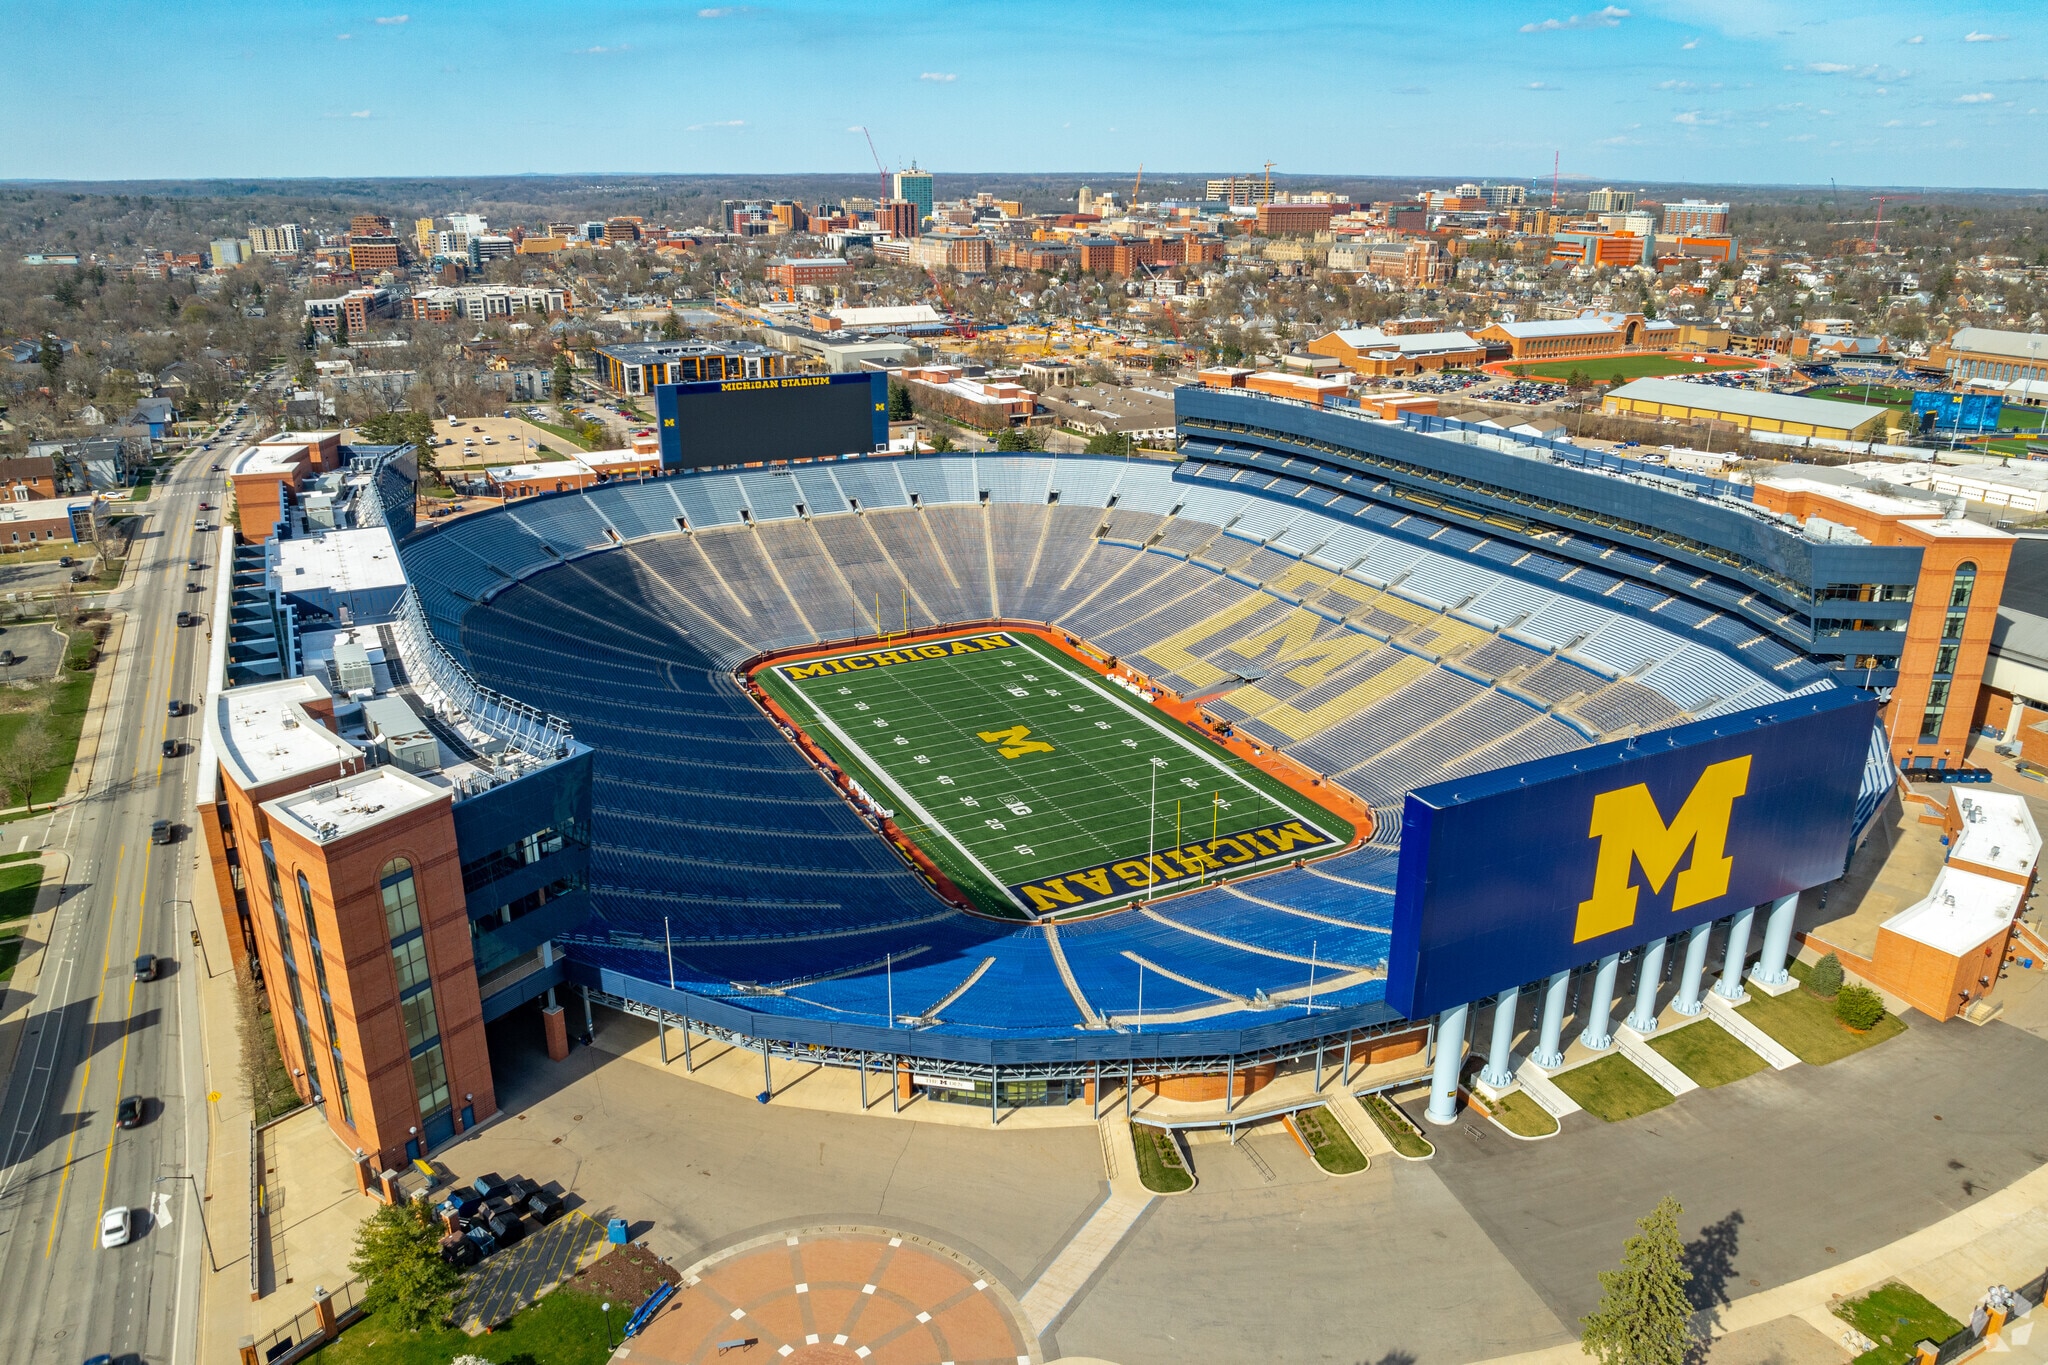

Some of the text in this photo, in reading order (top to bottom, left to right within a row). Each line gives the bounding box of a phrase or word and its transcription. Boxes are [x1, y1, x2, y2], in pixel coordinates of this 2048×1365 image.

[721, 376, 830, 392] MICHIGAN STADIUM
[875, 403, 885, 411] M
[664, 418, 675, 427] M
[1141, 563, 1498, 741] M
[783, 636, 1016, 681] MICHIGAN
[838, 687, 852, 695] 10
[854, 702, 870, 710] 20
[872, 718, 889, 728] 30
[1094, 721, 1112, 730] 50
[893, 737, 909, 745] 40
[976, 725, 1056, 760] M
[1121, 738, 1139, 748] 40
[913, 754, 931, 764] 50
[1149, 757, 1169, 768] 30
[936, 775, 954, 785] 40
[1180, 777, 1200, 789] 20
[960, 795, 979, 806] 30
[1212, 798, 1232, 809] 10
[984, 818, 1005, 829] 20
[1013, 844, 1033, 855] 10
[1573, 755, 1752, 944] M
[1020, 823, 1327, 912] MICHIGAN
[785, 1226, 997, 1286] CHAMPIONS PLAZA
